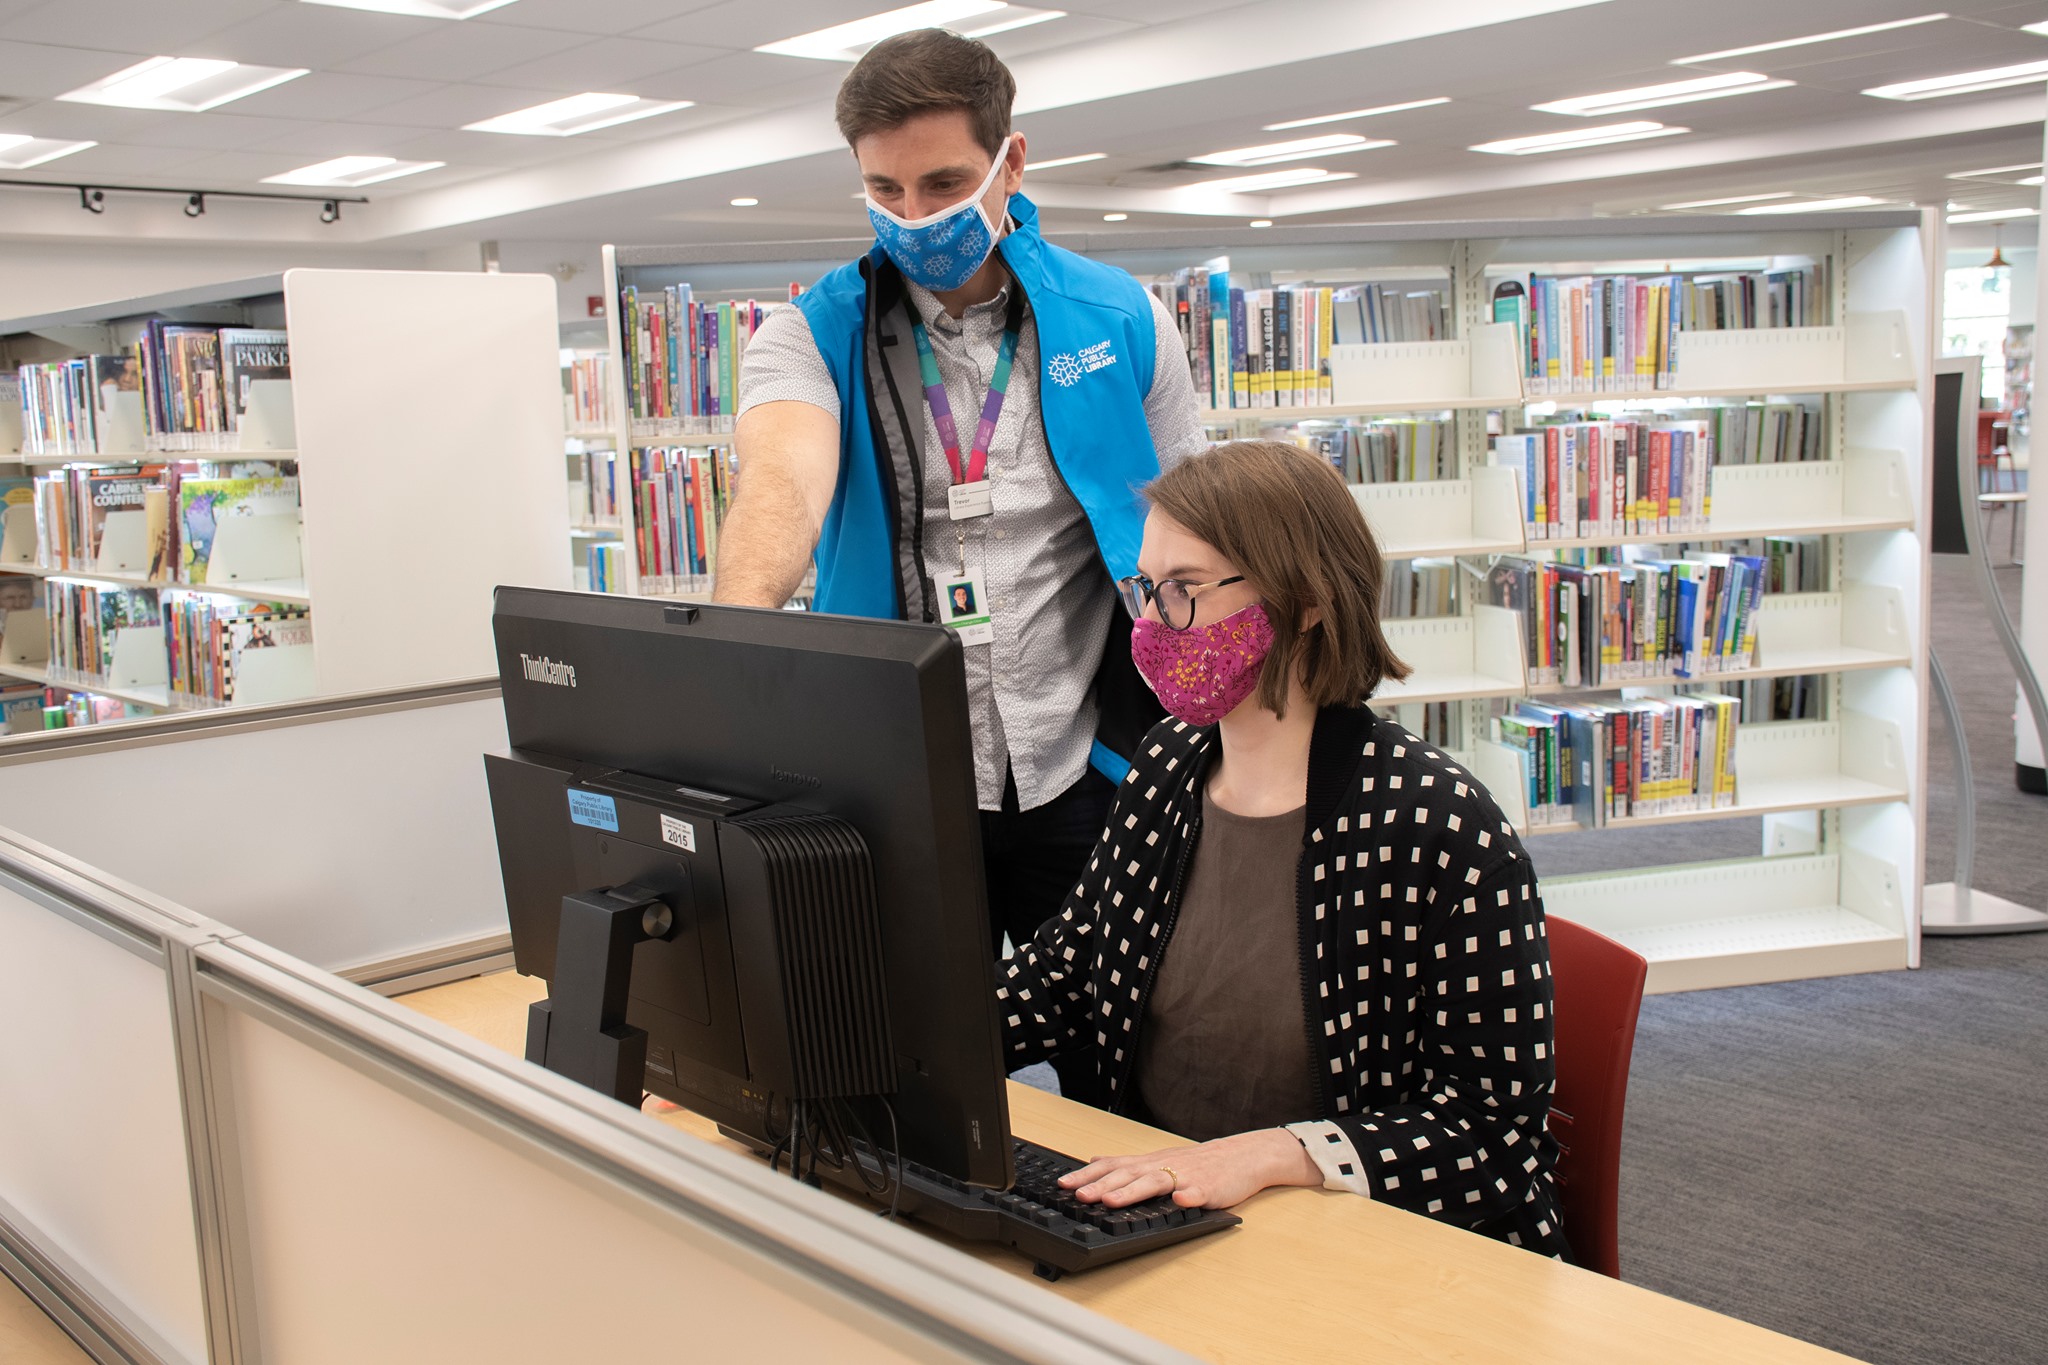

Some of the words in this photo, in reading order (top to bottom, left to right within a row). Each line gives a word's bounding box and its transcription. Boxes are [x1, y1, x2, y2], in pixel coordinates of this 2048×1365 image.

[1236, 301, 1244, 323] PAUL
[1278, 294, 1288, 310] THE
[1264, 309, 1274, 348] BOBBY
[1278, 313, 1288, 333] ONE
[1236, 325, 1245, 350] ANKA
[1078, 340, 1111, 357] CALGARY
[1081, 350, 1108, 366] PUBLIC
[235, 352, 289, 366] PARKE
[1084, 355, 1117, 373] LIBRARY
[1264, 350, 1275, 374] BRO
[520, 653, 577, 688] ThinkCentre
[1662, 719, 1672, 742] KELLY
[1615, 761, 1628, 794] MIKE
[572, 799, 587, 807] Calgary
[598, 804, 613, 812] Library
[667, 829, 688, 847] 2015
